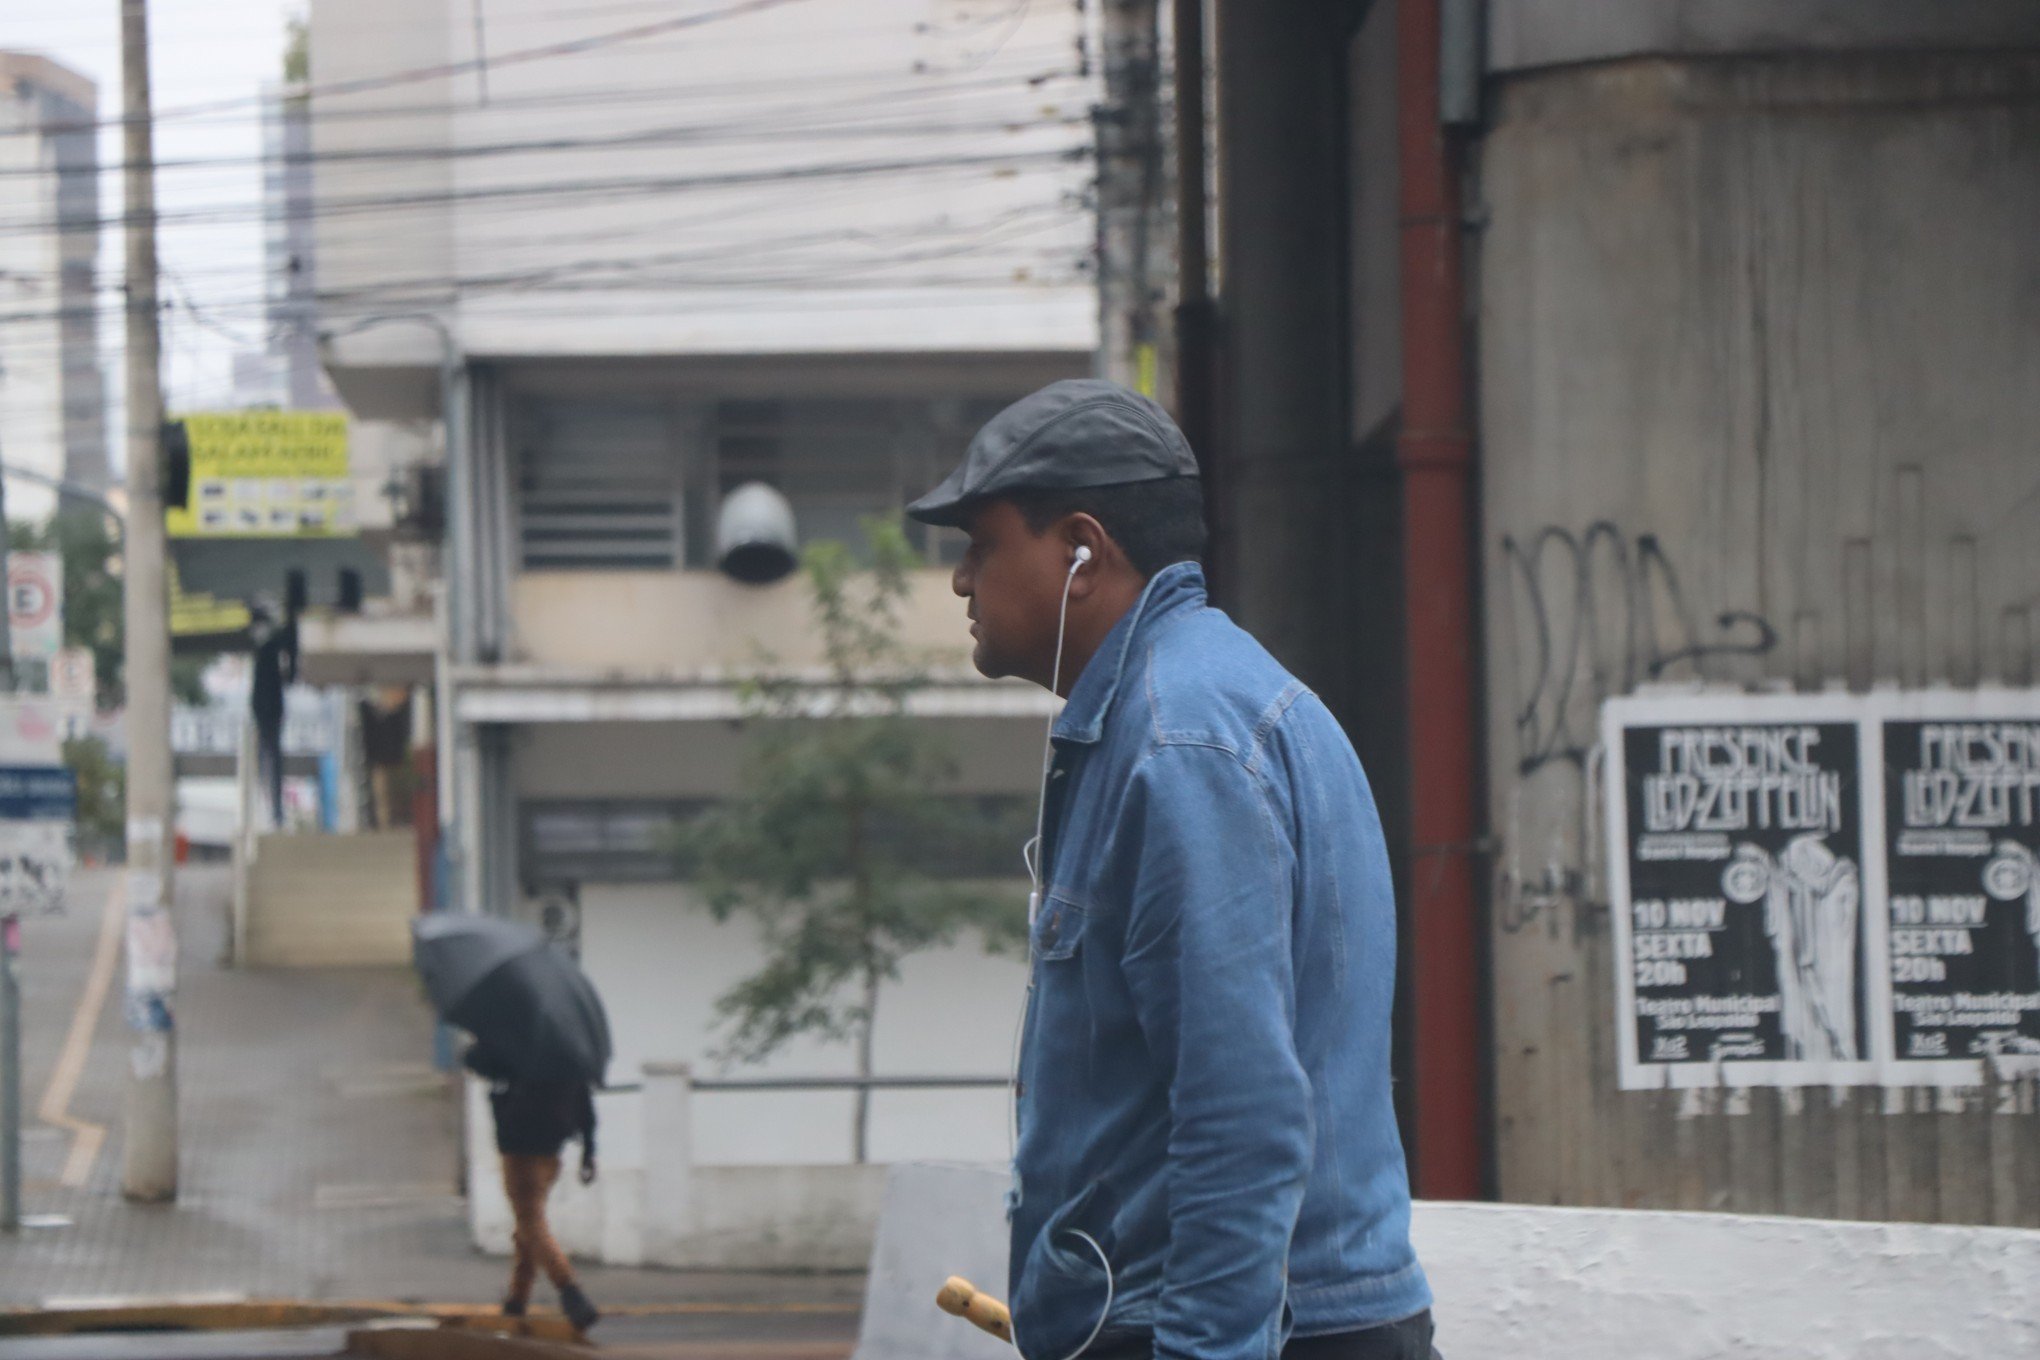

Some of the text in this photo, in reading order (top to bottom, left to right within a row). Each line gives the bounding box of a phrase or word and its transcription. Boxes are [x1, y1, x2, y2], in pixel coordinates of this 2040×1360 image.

[1659, 727, 1820, 774] PRESENCE
[1634, 898, 1726, 928] 10 NOV
[1891, 894, 1987, 924] 10 NOV
[1635, 932, 1713, 960] SEXTA
[1892, 928, 1974, 956] SEXTA
[1636, 960, 1687, 986] 20h
[1894, 957, 1946, 982] 20h
